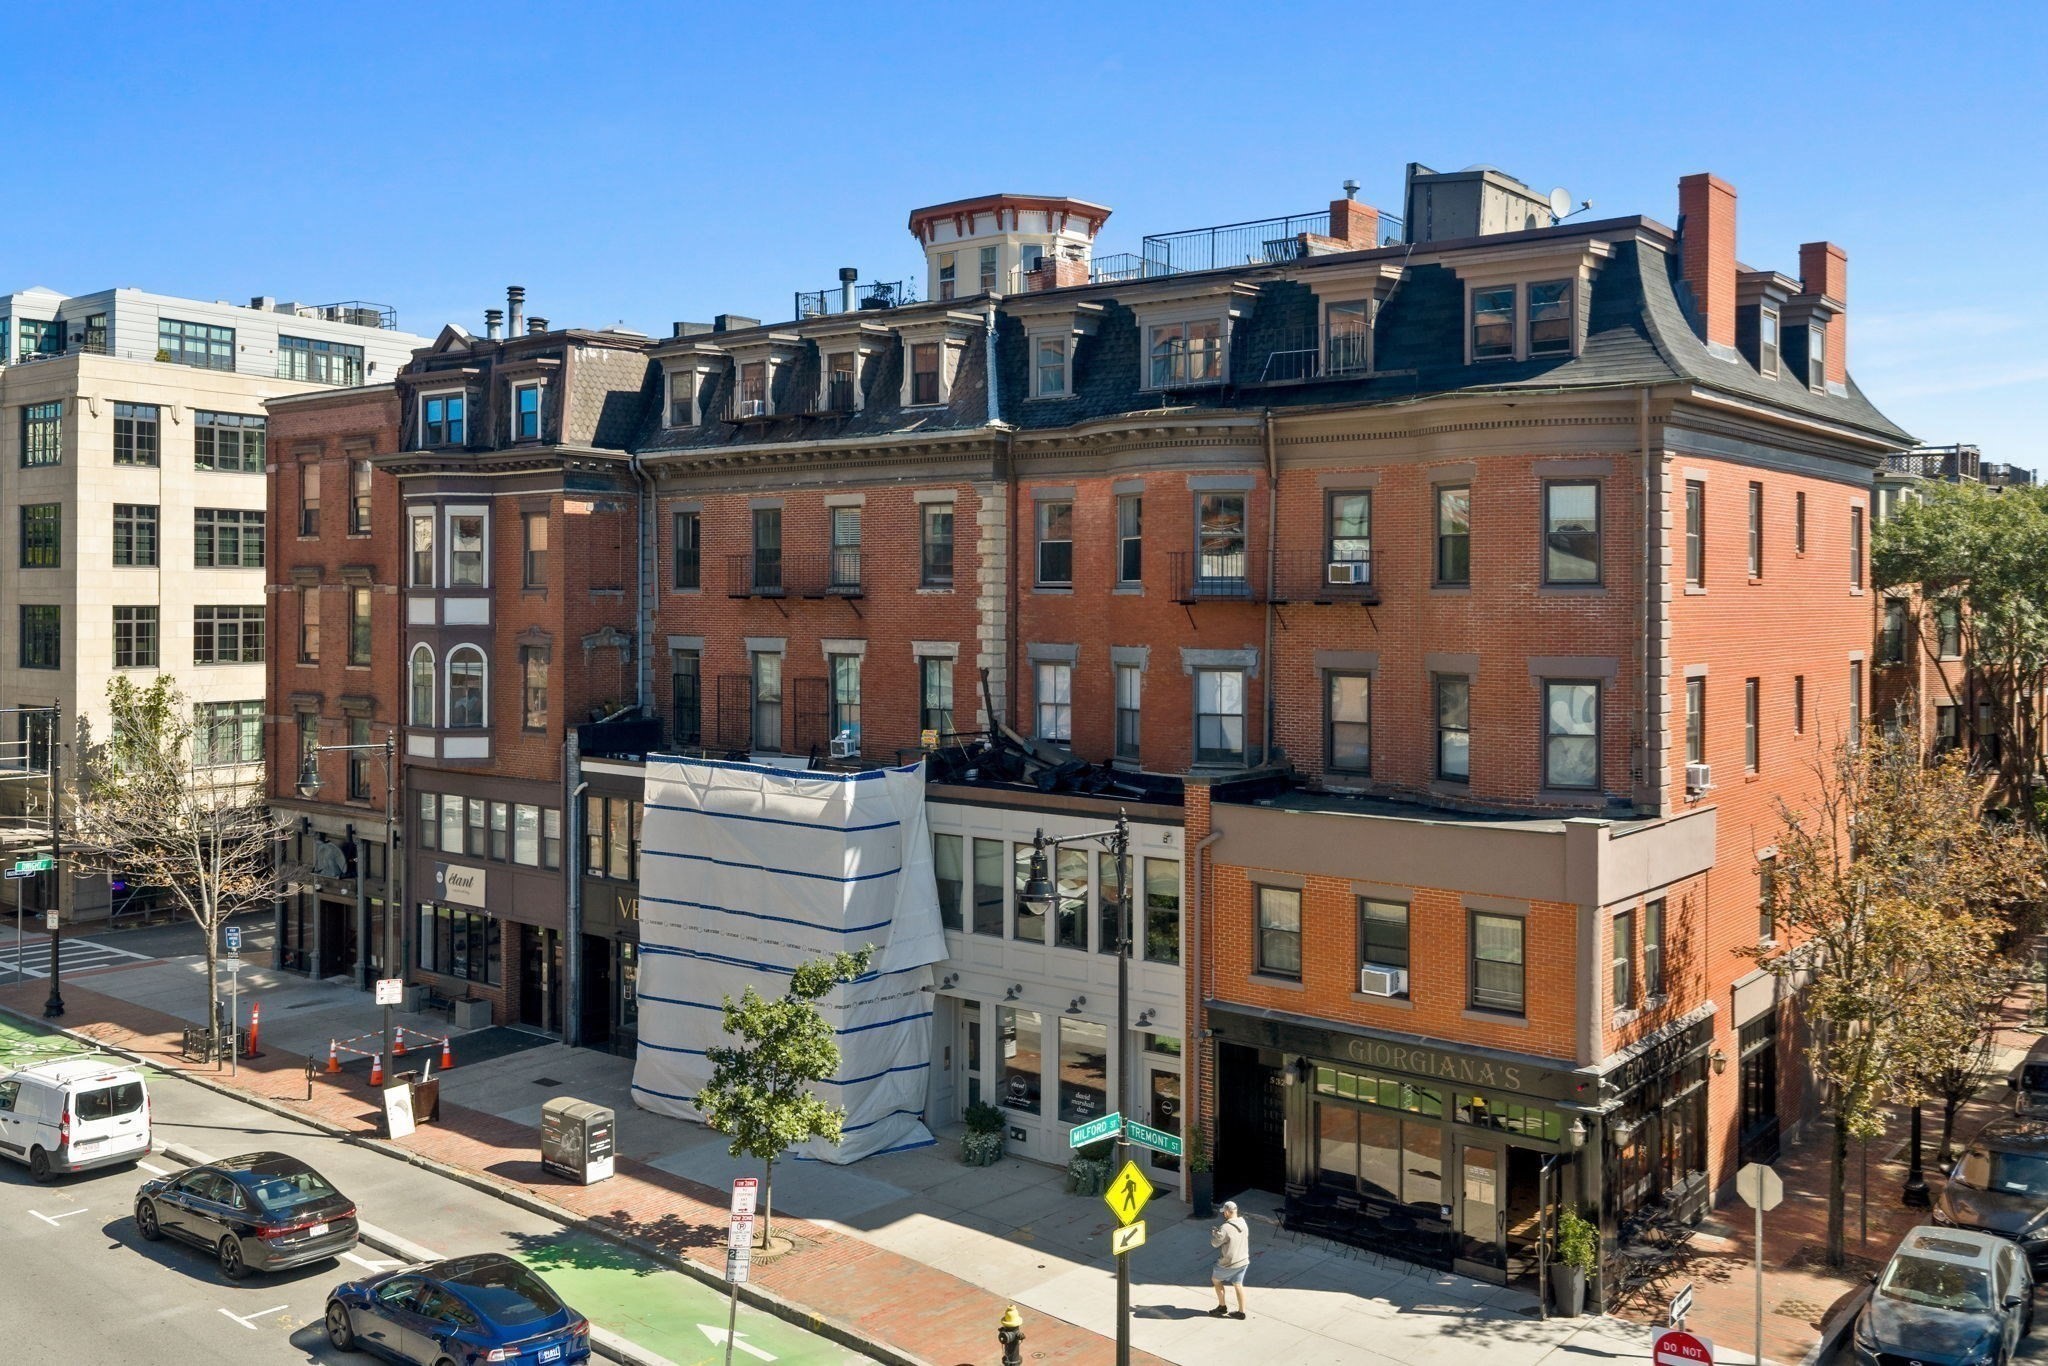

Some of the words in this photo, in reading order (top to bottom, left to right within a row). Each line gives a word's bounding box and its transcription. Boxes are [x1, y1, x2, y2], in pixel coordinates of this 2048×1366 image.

[448, 872, 474, 888] étant
[1348, 1039, 1520, 1090] GIORGIANA'S
[1071, 1099, 1095, 1108] marshall
[1075, 1092, 1091, 1101] david
[1073, 1122, 1107, 1142] MILFORD
[1110, 1120, 1116, 1128] ST
[1130, 1125, 1169, 1148] TREMONT
[1171, 1142, 1179, 1151] ST
[1663, 1342, 1677, 1352] DO
[1682, 1346, 1702, 1358] NOT
